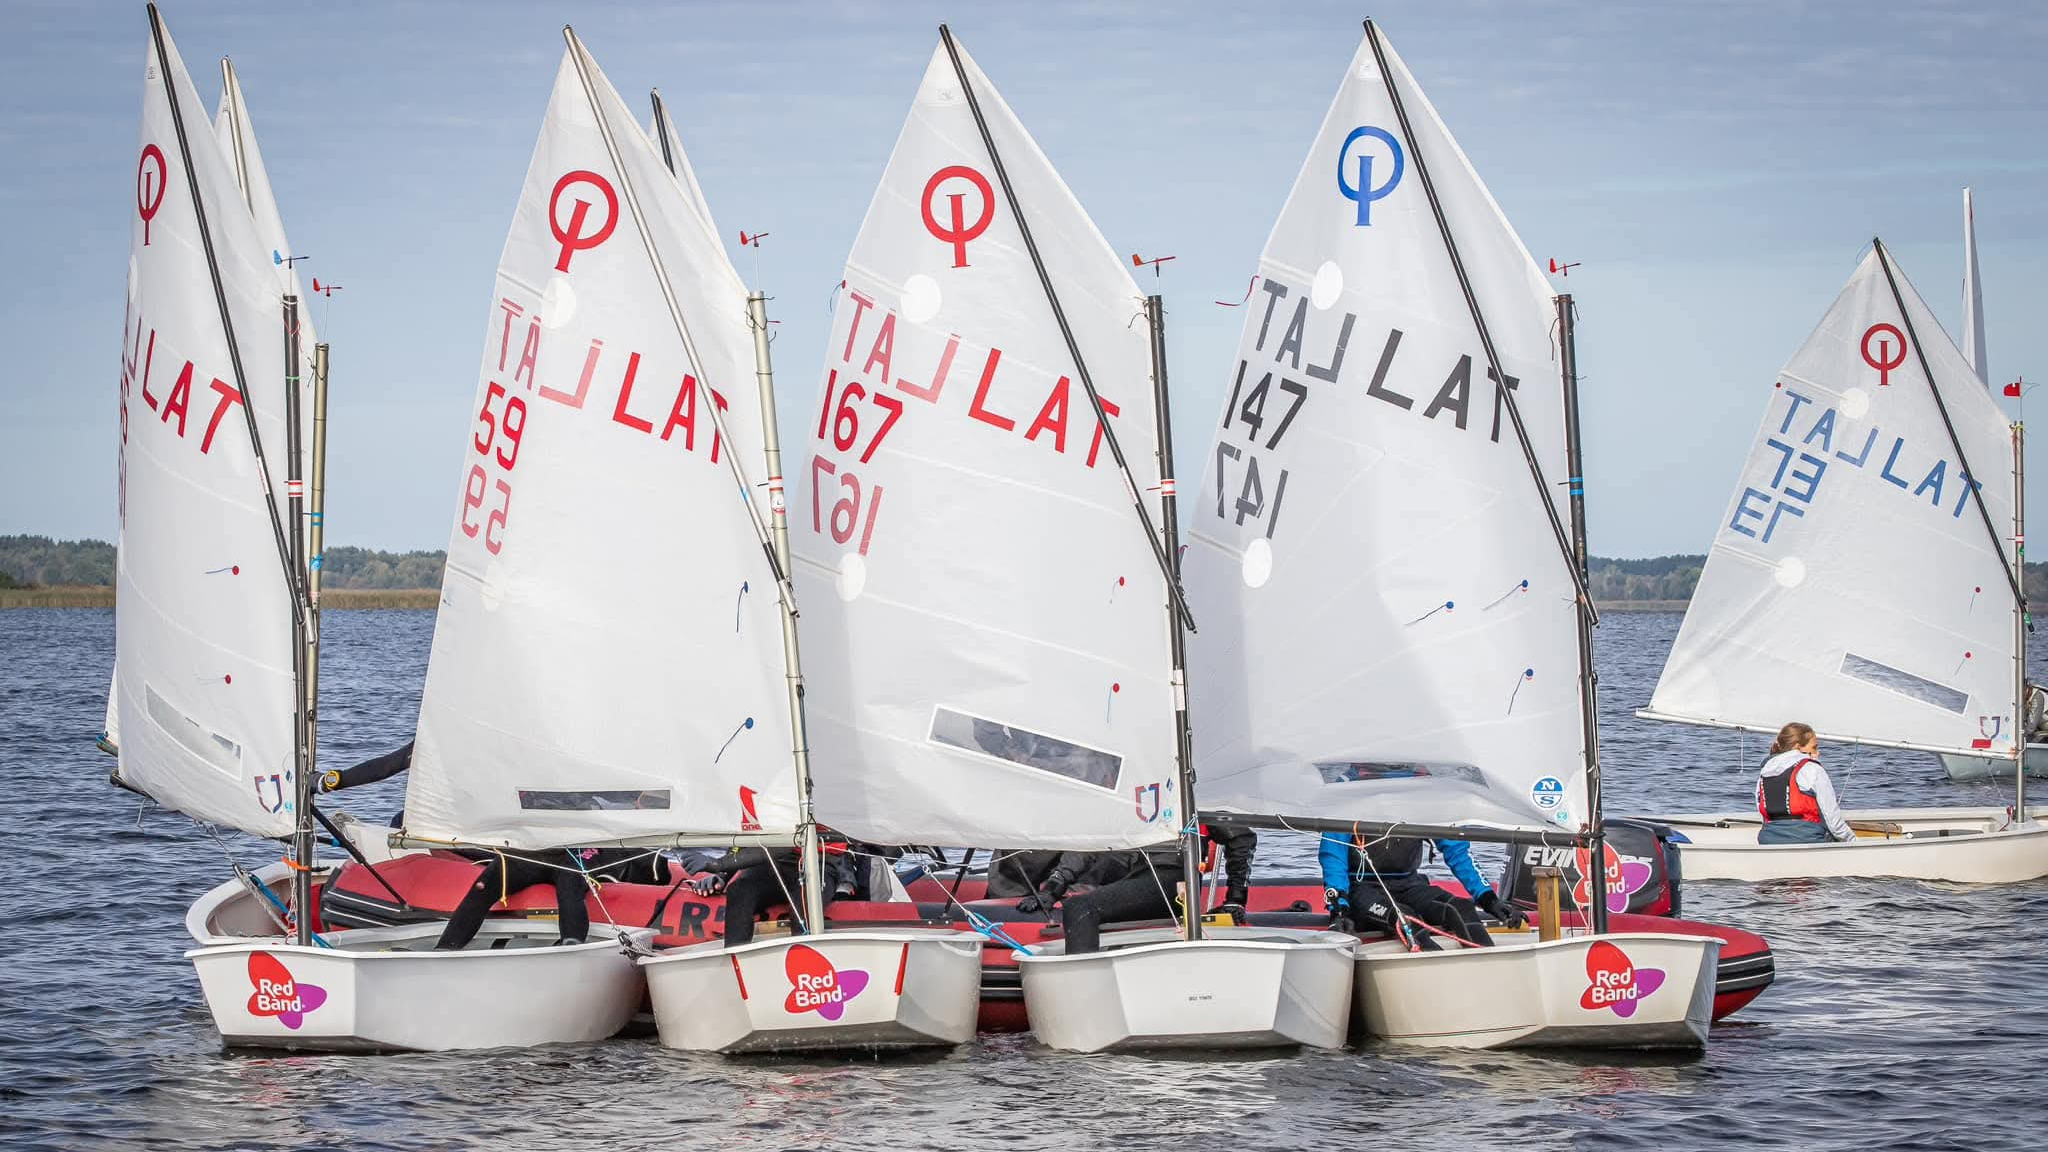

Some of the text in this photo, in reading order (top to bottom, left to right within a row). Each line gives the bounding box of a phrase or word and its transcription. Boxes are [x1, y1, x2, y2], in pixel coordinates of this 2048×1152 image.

[142, 329, 244, 455] LAT
[474, 381, 527, 471] 59
[612, 352, 729, 464] LAT
[817, 369, 903, 464] 167
[968, 347, 1121, 469] LAT
[1223, 359, 1308, 451] 147
[1367, 328, 1520, 443] LAT
[1767, 438, 1828, 504] 73
[1880, 437, 1983, 518] LAT
[258, 995, 301, 1012] Band
[260, 978, 293, 998] Red
[796, 985, 842, 1007] Band
[797, 970, 834, 992] Red
[1592, 983, 1637, 1003] Band
[1596, 967, 1631, 988] Red
